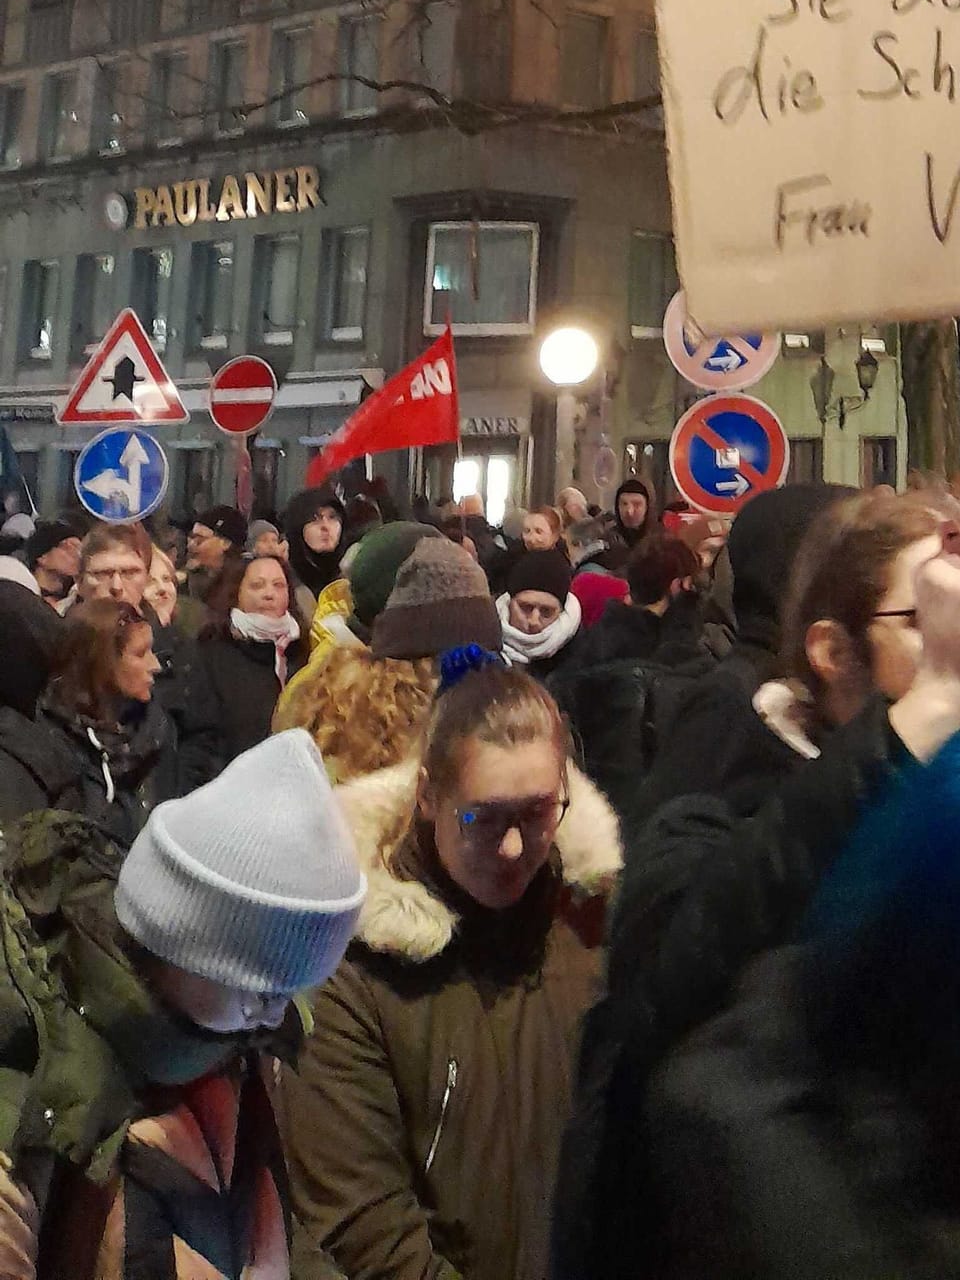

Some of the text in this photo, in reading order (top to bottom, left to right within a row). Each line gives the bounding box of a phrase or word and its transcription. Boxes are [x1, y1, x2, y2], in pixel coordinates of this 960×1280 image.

[712, 23, 827, 124] die
[133, 165, 326, 230] PAULANER
[773, 173, 873, 254] Frau
